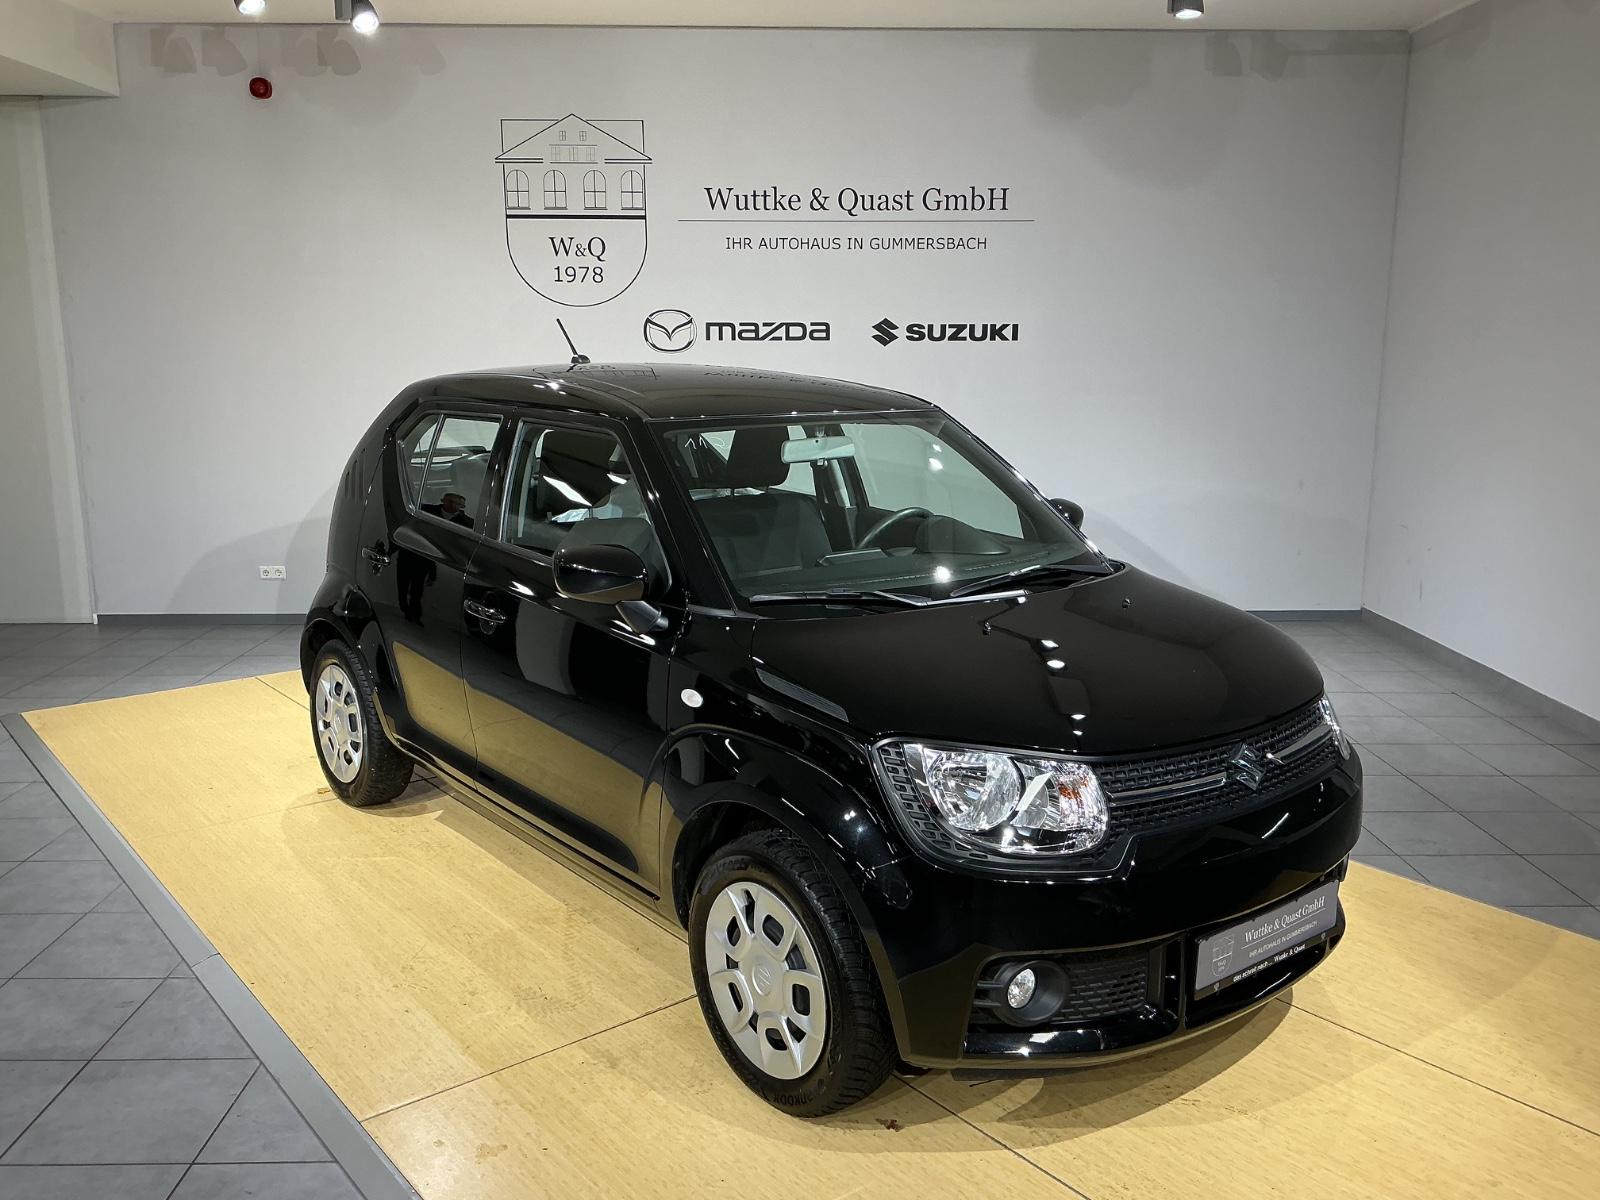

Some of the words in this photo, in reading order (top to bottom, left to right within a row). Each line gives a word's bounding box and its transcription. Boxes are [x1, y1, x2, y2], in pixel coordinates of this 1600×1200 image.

[704, 186, 801, 212] Wuttke
[810, 188, 831, 212] &
[838, 188, 914, 217] Quast
[923, 186, 1011, 212] GmbH
[548, 236, 606, 262] W&Q
[725, 236, 754, 250] IHR
[758, 237, 842, 250] AUTOHAUS
[847, 237, 864, 250] IN
[870, 236, 987, 251] GUMMERSBACH
[553, 266, 604, 283] 1978
[905, 323, 1020, 342] SUZUKI
[1245, 923, 1272, 943] Wuttke
[1273, 918, 1281, 930] &
[1281, 908, 1303, 928] Quast
[1302, 896, 1325, 916] GmbH
